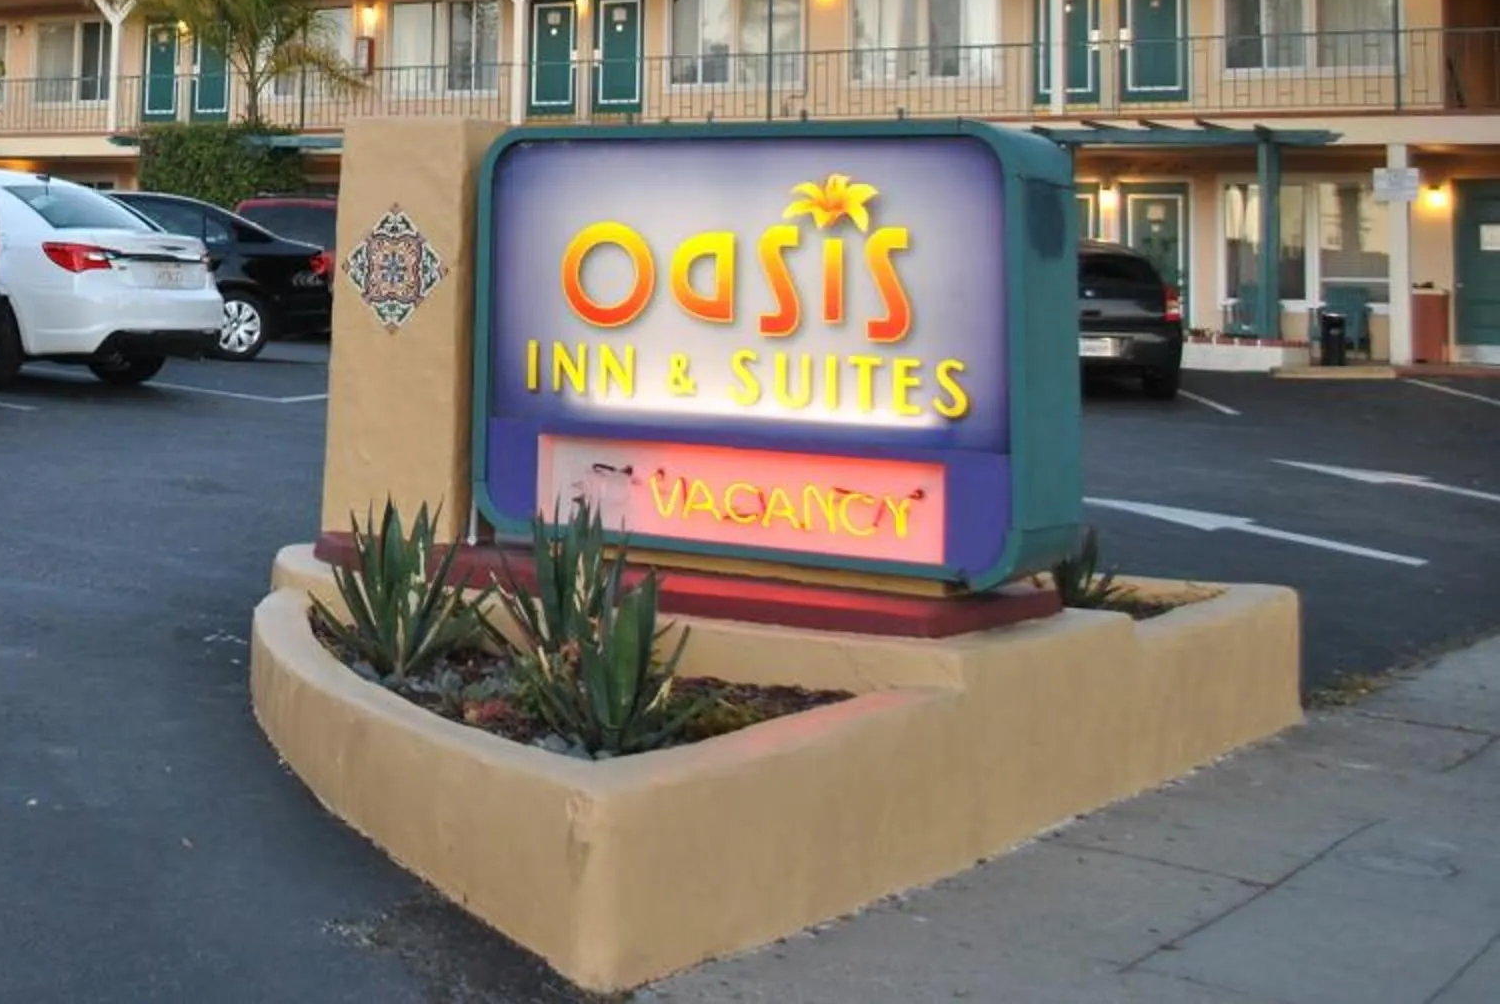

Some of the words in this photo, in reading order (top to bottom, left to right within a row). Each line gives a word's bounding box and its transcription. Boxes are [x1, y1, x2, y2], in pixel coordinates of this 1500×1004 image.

[526, 339, 637, 396] INN
[669, 353, 697, 395] &
[730, 350, 969, 419] SUITES
[649, 474, 912, 539] VACANCY
